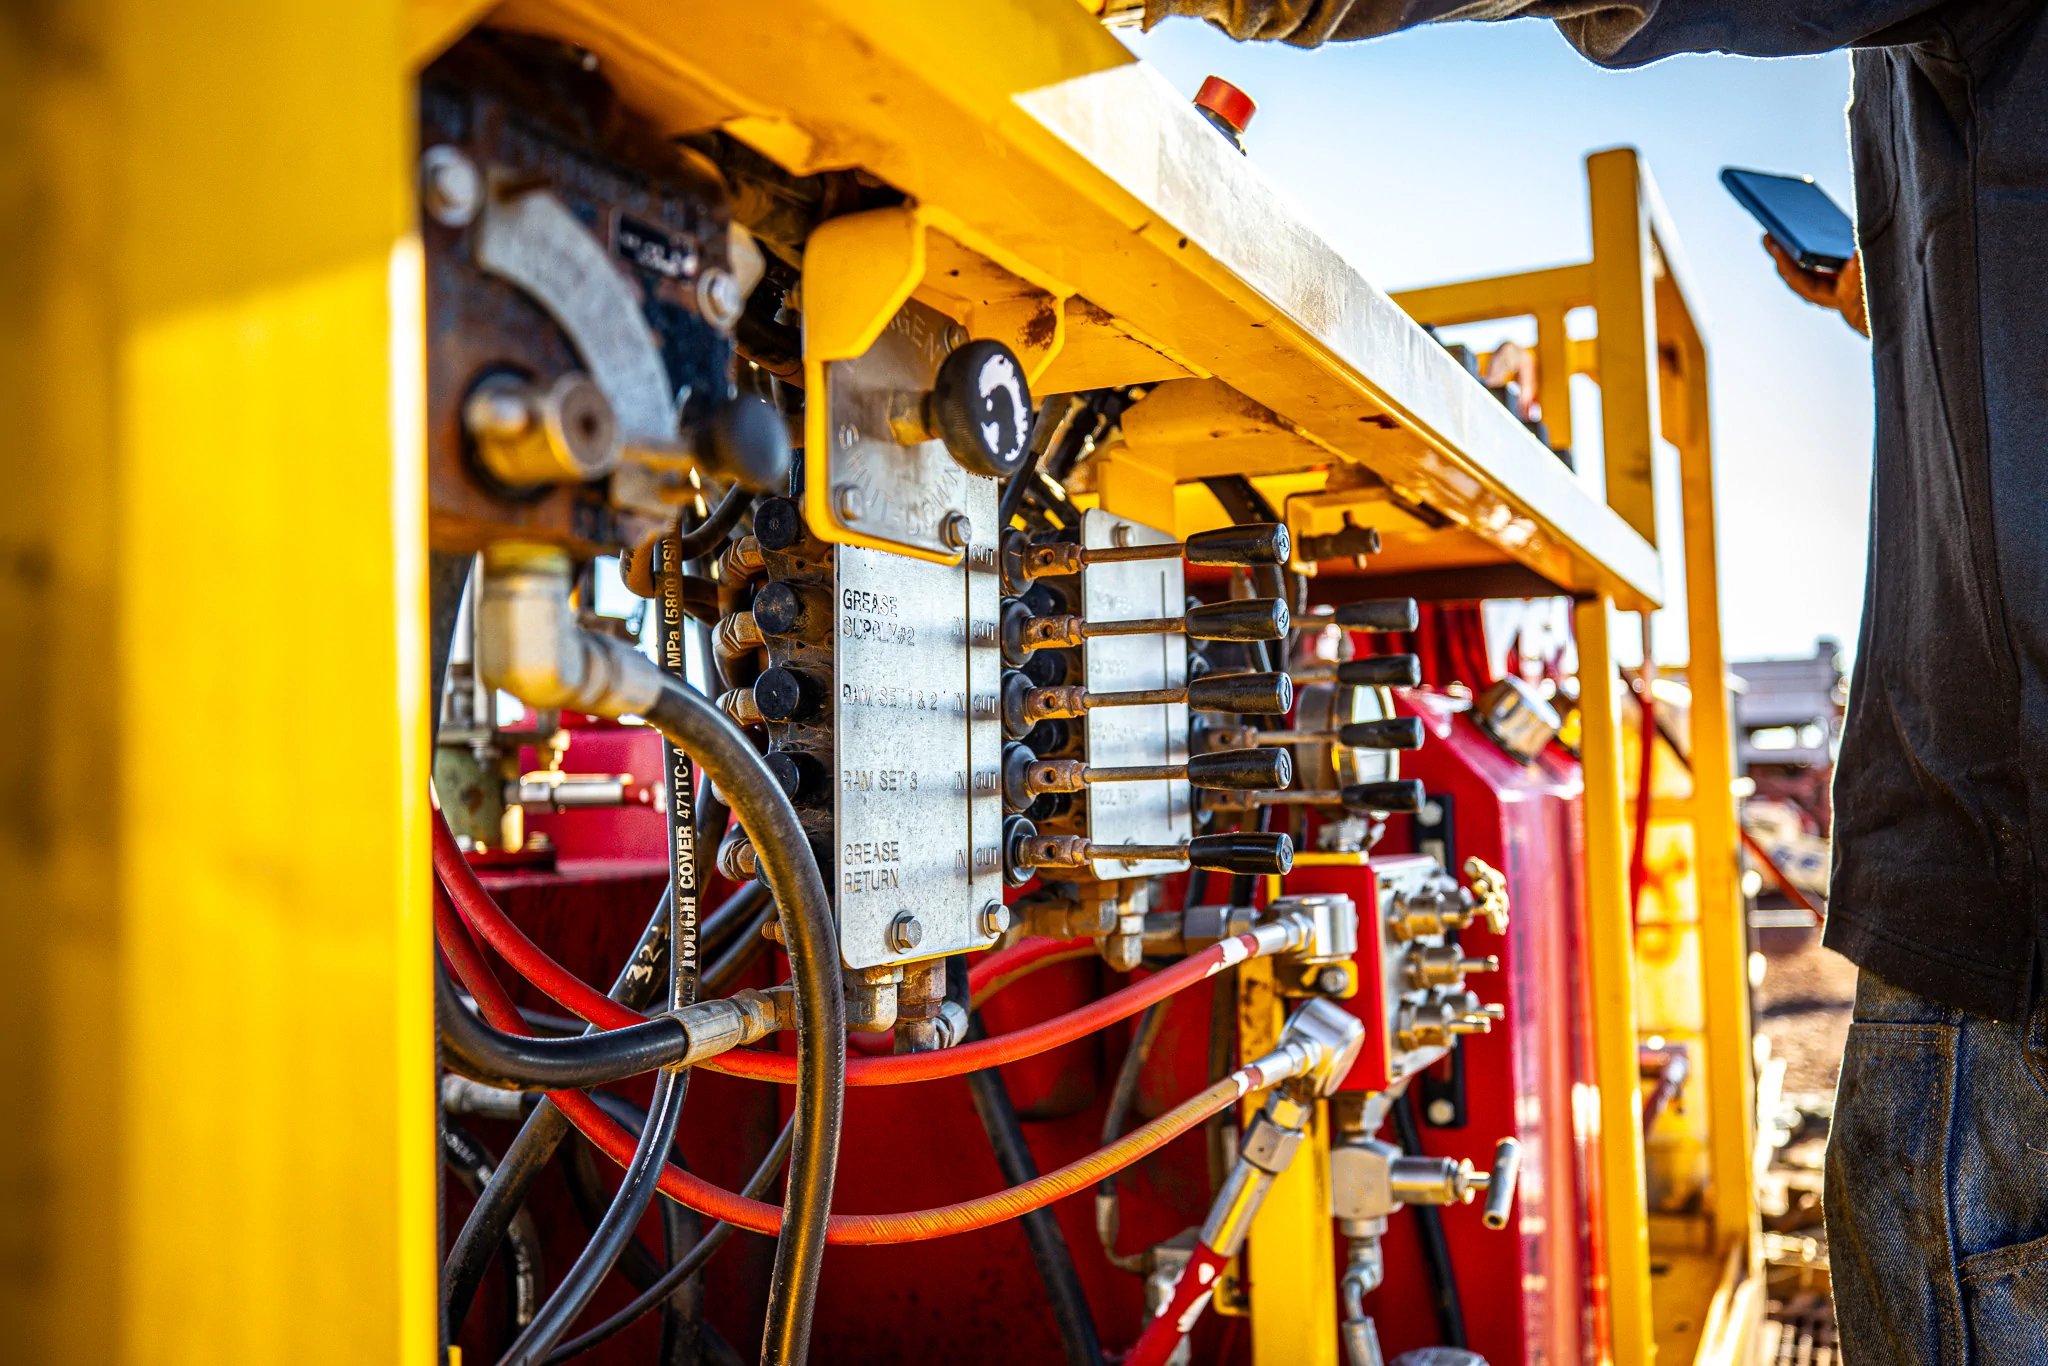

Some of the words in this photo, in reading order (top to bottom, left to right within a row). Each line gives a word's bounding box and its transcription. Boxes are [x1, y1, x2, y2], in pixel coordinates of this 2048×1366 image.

[972, 544, 995, 566] OUT
[664, 578, 679, 625] (5800
[843, 588, 898, 617] GREASE
[953, 616, 965, 637] IN
[973, 620, 995, 641] OUT
[667, 630, 681, 667] MPa
[843, 683, 874, 707] RAM
[879, 687, 905, 708] SET
[930, 691, 938, 711] 2
[954, 692, 966, 712] IN
[974, 694, 996, 714] OUT
[843, 770, 874, 792] RAM
[879, 769, 905, 792] SET
[955, 771, 966, 790] IN
[975, 771, 998, 790] OUT
[677, 825, 695, 890] COVER
[844, 841, 900, 866] GREASE
[956, 849, 967, 869] IN
[975, 847, 998, 867] OUT
[844, 868, 899, 894] RETURN
